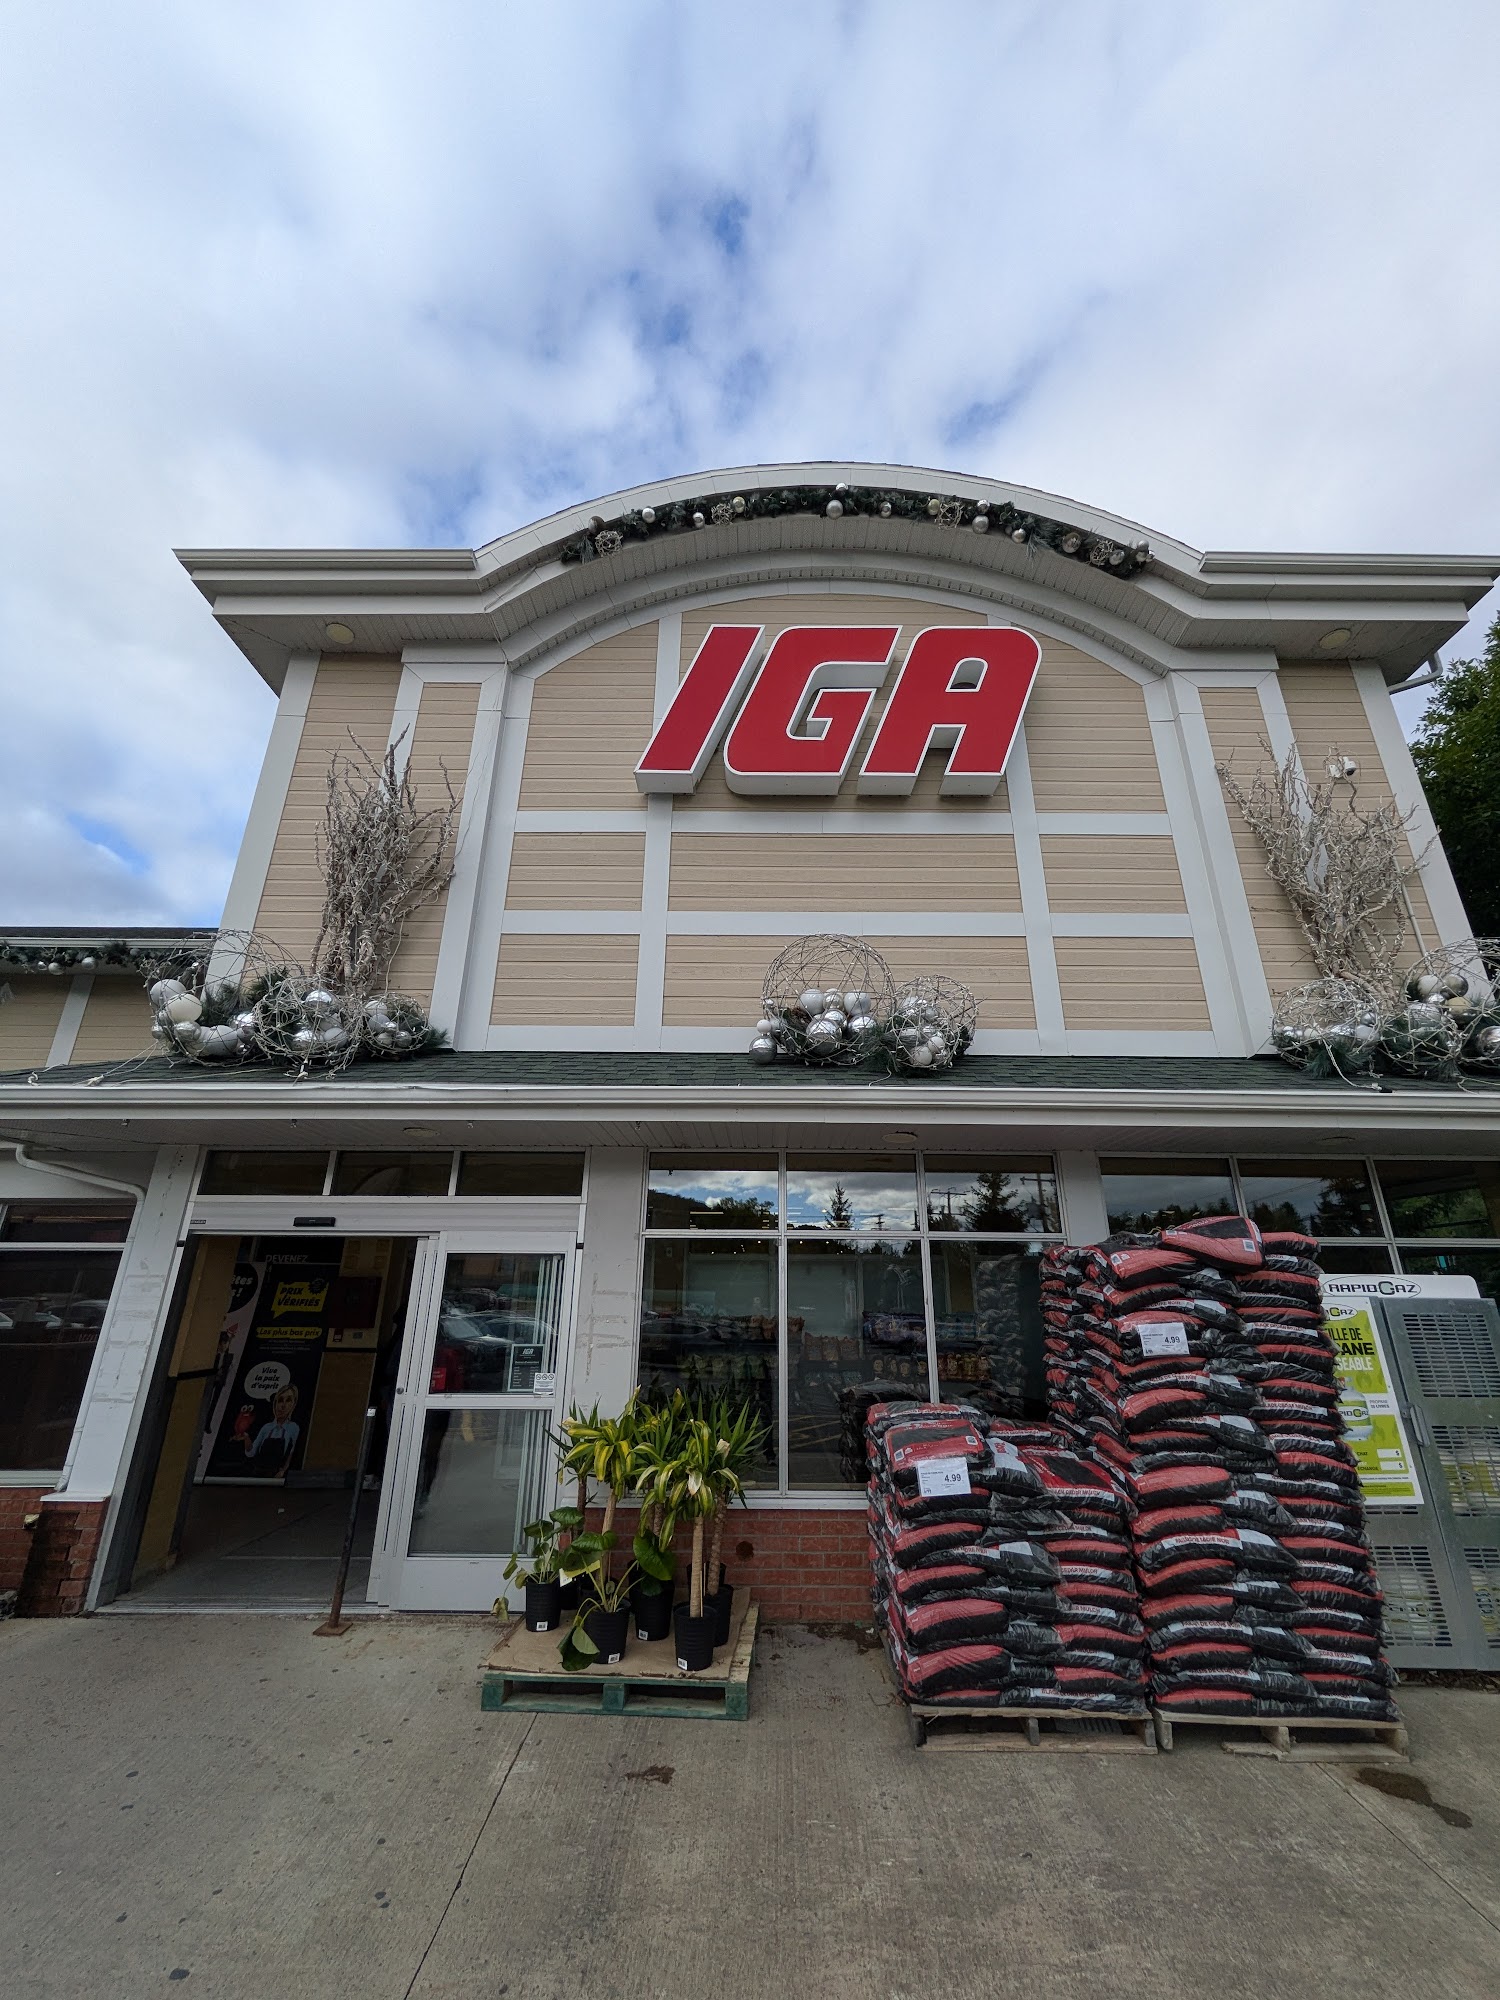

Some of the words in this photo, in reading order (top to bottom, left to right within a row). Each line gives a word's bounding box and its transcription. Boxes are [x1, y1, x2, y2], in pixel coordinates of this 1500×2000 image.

[634, 624, 1044, 784] IGA
[265, 1254, 309, 1263] DEVENEZ
[280, 1287, 305, 1296] PRIX
[1328, 1281, 1418, 1295] RAPIDGAZ
[277, 1295, 321, 1307] VÉRIFIÉS
[259, 1328, 271, 1336] Les
[272, 1328, 288, 1338] plus
[290, 1328, 303, 1336] bas
[304, 1329, 321, 1339] prix
[1350, 1327, 1364, 1341] DE
[1163, 1335, 1182, 1344] 4.99
[1339, 1342, 1376, 1356] ANE
[254, 1374, 263, 1382] la
[264, 1374, 280, 1382] paix
[252, 1382, 279, 1390] d'esprit
[944, 1473, 962, 1483] 4.99
